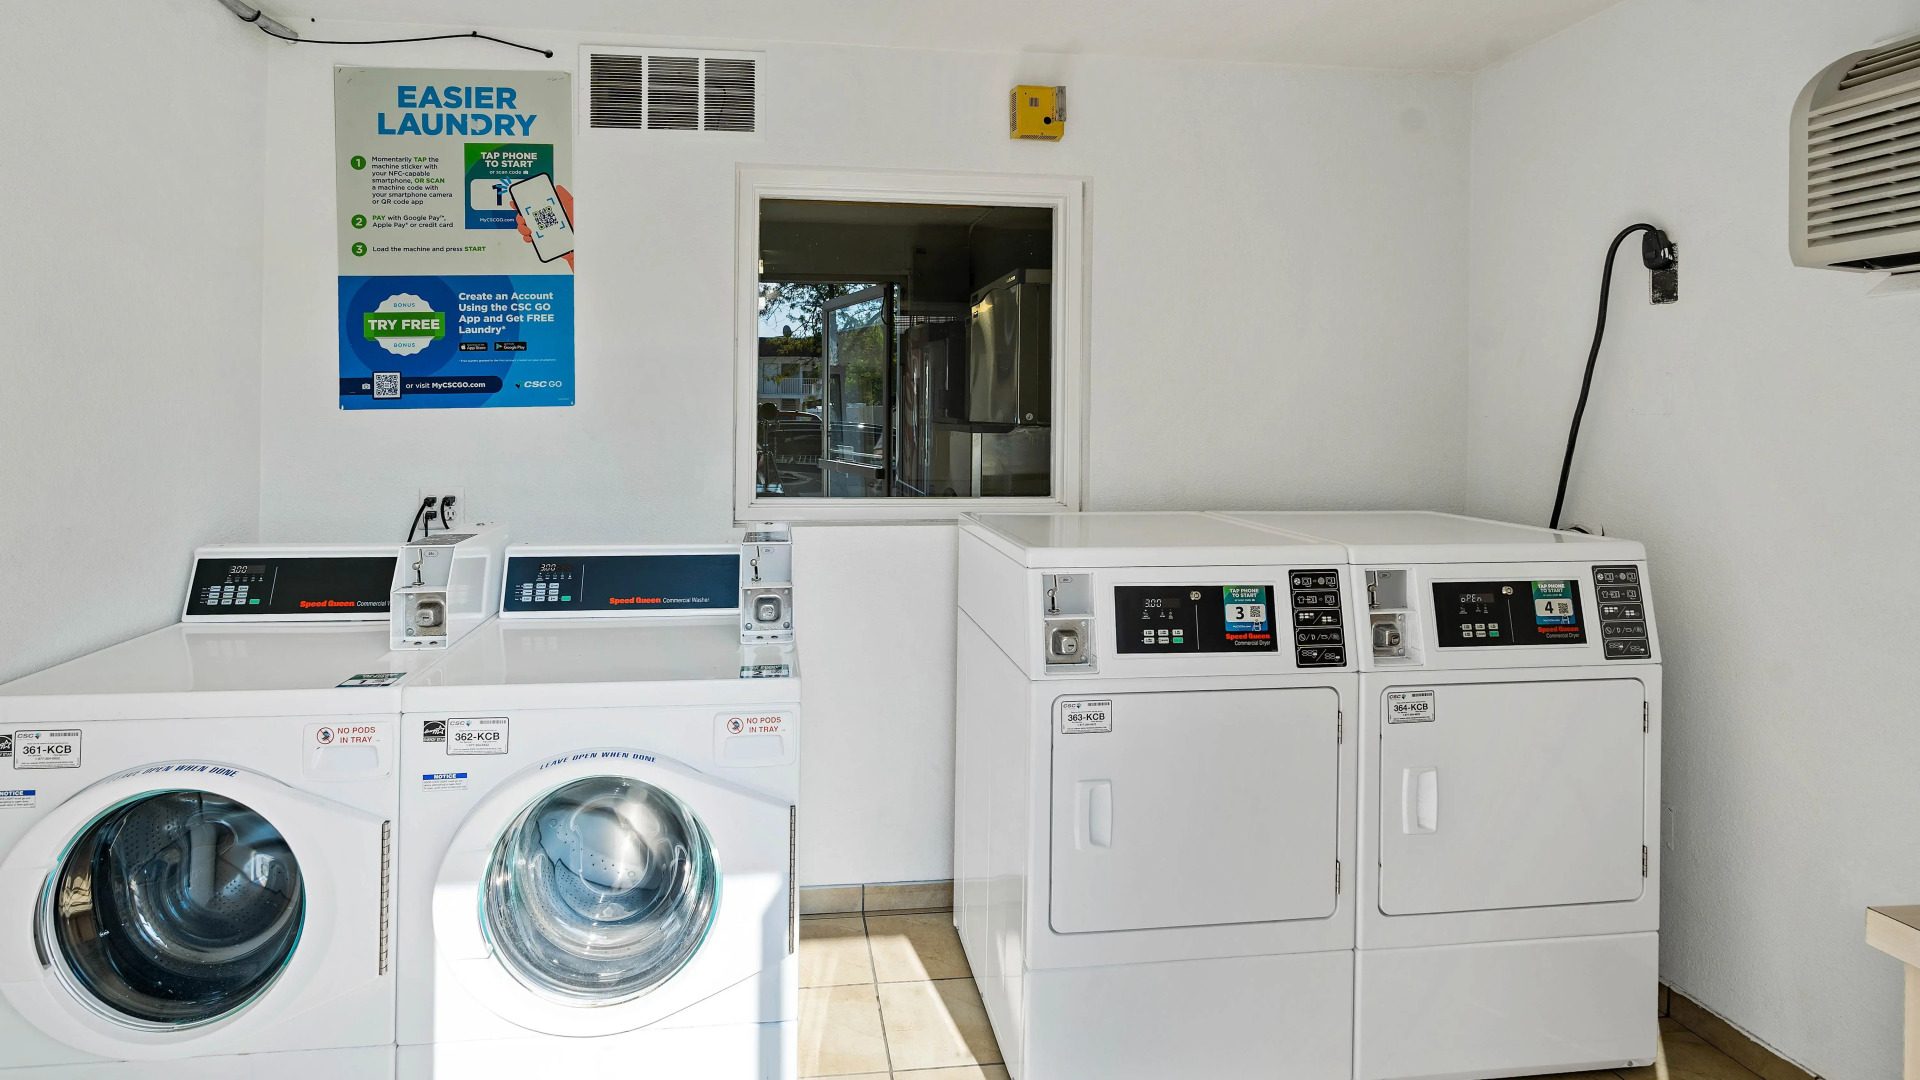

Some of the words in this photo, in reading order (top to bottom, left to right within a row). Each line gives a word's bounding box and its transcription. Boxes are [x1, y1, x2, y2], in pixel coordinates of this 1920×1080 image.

[397, 85, 517, 110] EASIER
[377, 112, 537, 137] LAUNDRY
[480, 152, 500, 160] TAP
[502, 152, 538, 160] PHONE
[355, 159, 360, 167] 1
[485, 160, 499, 168] TO
[501, 160, 533, 168] START
[492, 184, 502, 206] 1
[355, 217, 363, 226] 2
[356, 245, 363, 254] 3
[458, 292, 493, 300] Create
[511, 292, 553, 300] Account
[458, 303, 488, 313] Using
[491, 303, 508, 311] the
[510, 303, 531, 311] CSC
[534, 303, 551, 311] GO
[458, 315, 481, 324] App
[483, 314, 503, 322] and
[506, 314, 524, 322] Get
[526, 314, 555, 322] FREE
[368, 320, 397, 331] TRY
[401, 319, 440, 331] FREE
[431, 381, 486, 389] MyCSCGO.com
[300, 600, 327, 608] Speed
[609, 597, 635, 605] Speed
[1545, 601, 1554, 614] 4
[1236, 606, 1244, 620] 3
[1394, 703, 1429, 712] 364-KCB
[1068, 713, 1105, 722] 363-KCB
[352, 726, 376, 734] PODS
[455, 732, 500, 741] 362-KCB
[23, 745, 72, 754] 361-KCB
[539, 757, 569, 770] LEAVE
[572, 752, 597, 761] OPEN
[632, 754, 657, 763] DONE
[208, 767, 240, 777] DONE
